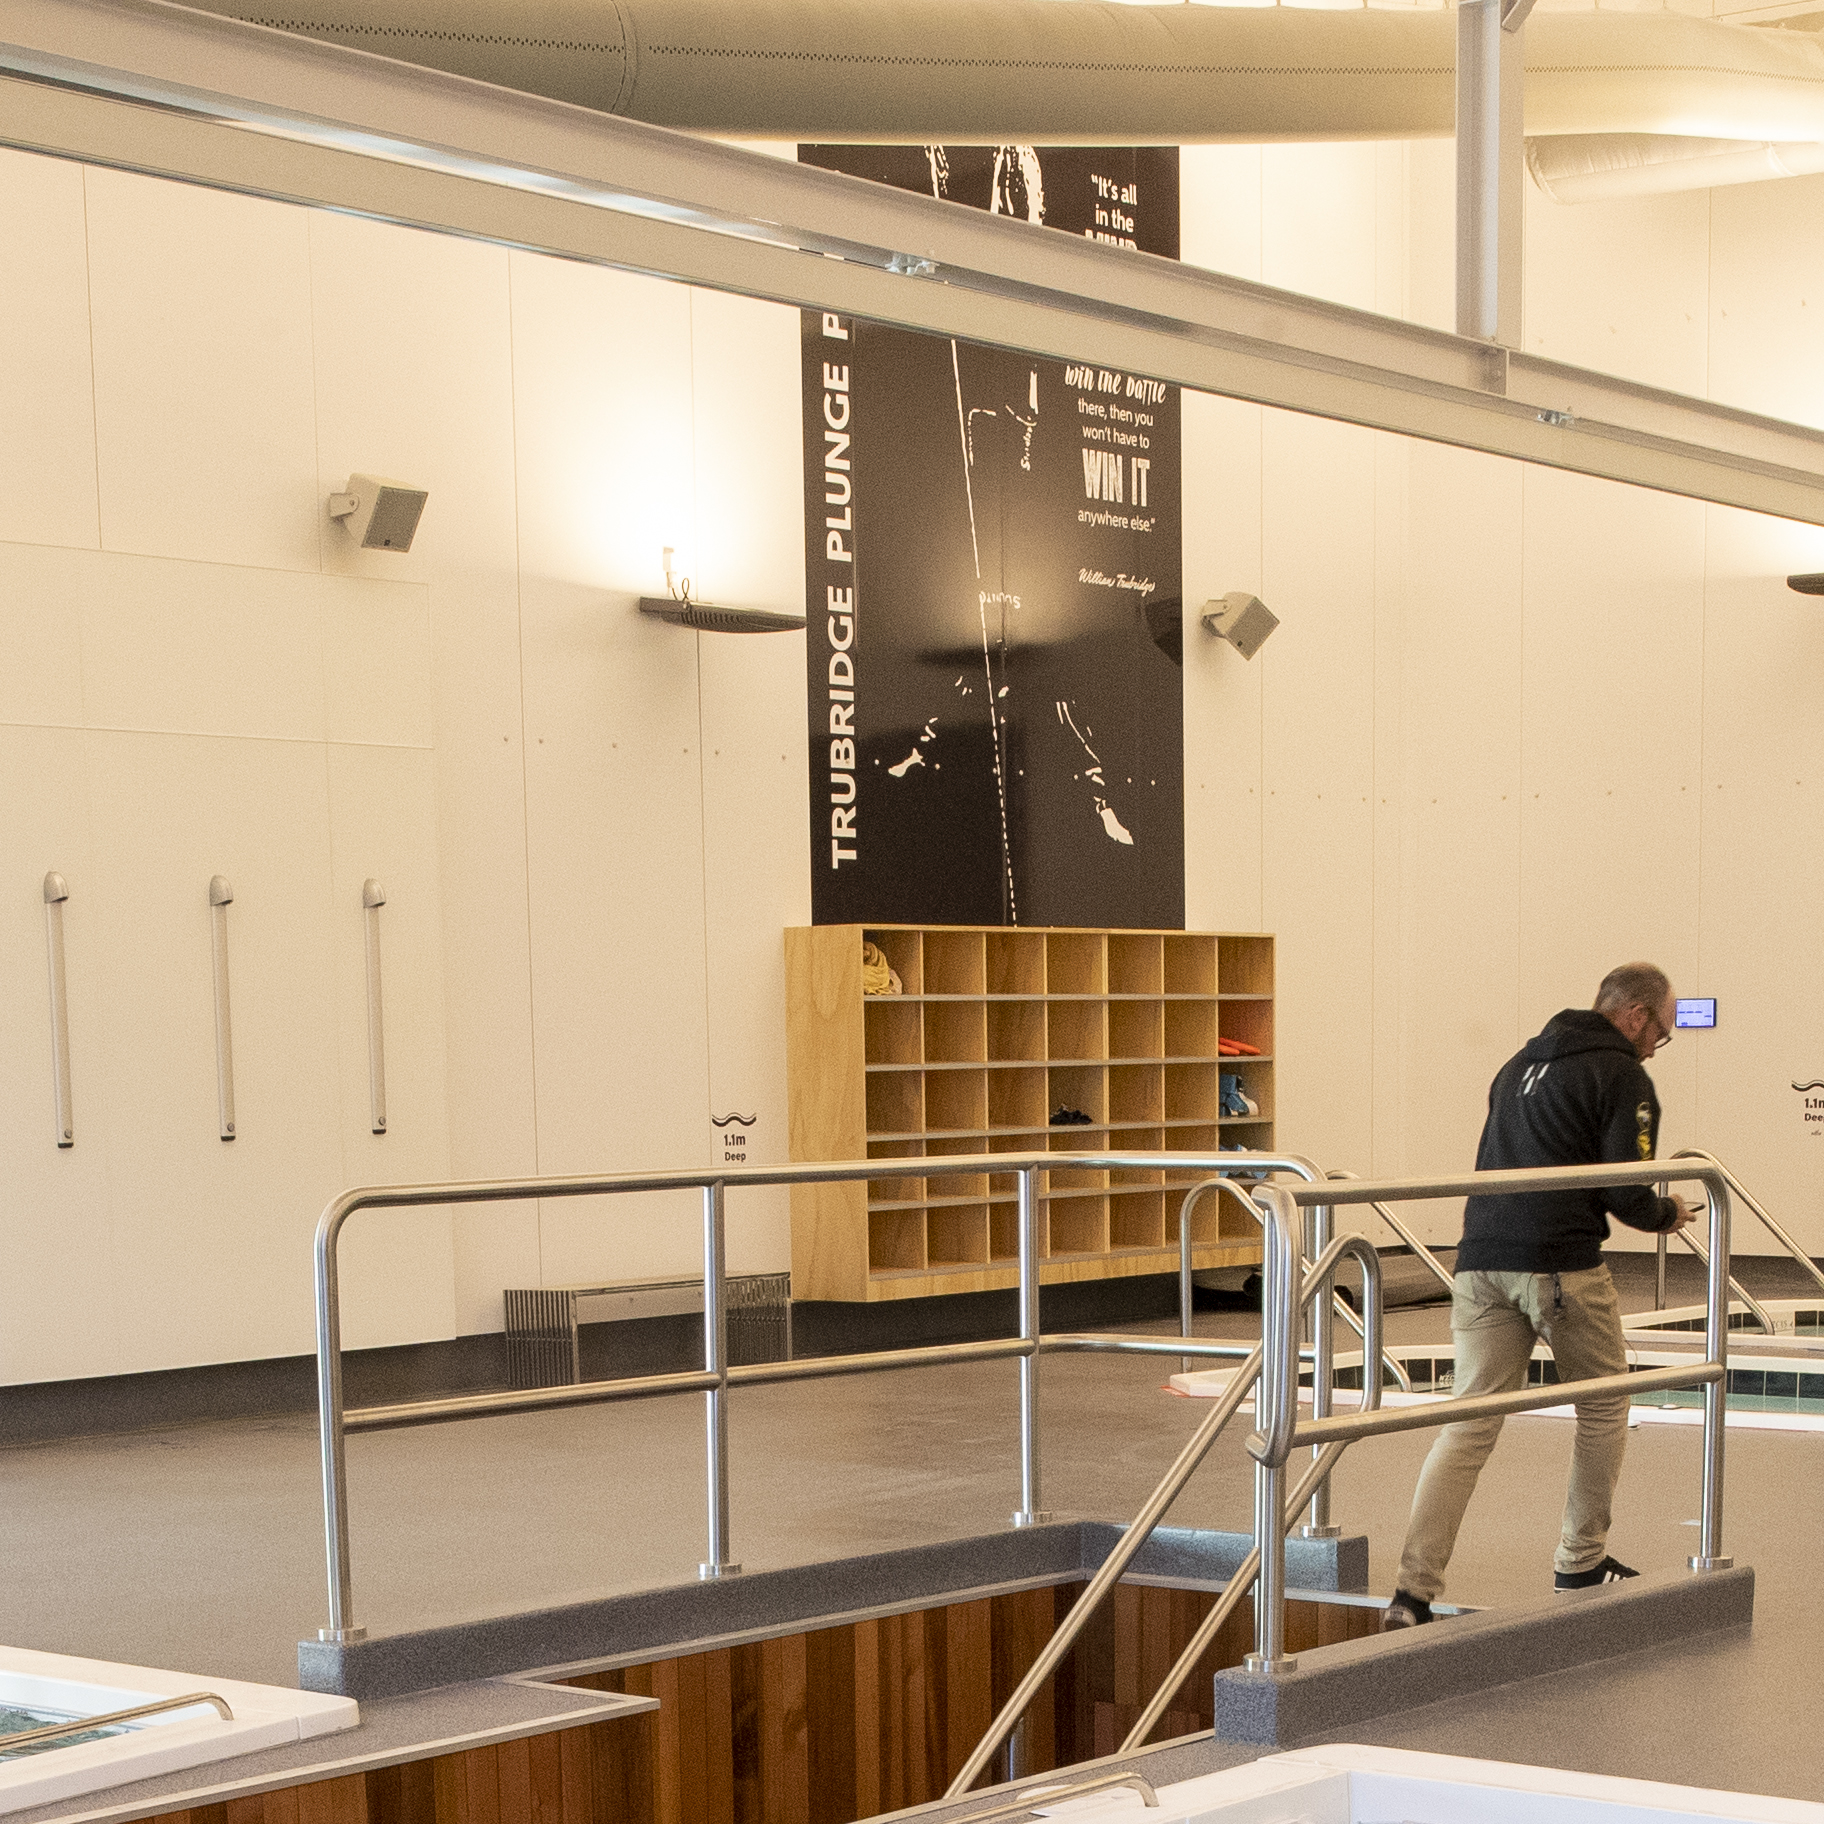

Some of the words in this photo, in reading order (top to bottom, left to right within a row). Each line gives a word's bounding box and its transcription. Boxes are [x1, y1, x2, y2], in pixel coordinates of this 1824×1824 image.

[1120, 183, 1138, 206] all
[1095, 203, 1109, 226] in
[1111, 209, 1134, 232] the
[1078, 397, 1107, 420] there,
[1109, 404, 1133, 423] then
[1135, 412, 1153, 427] you
[1082, 425, 1111, 443] won't
[1113, 427, 1138, 447] have
[1139, 433, 1150, 449] to
[821, 361, 854, 563] PLUNGE
[1082, 447, 1123, 504] WIN
[1131, 456, 1151, 508] IT
[1077, 509, 1129, 529] anywhere
[826, 586, 858, 869] TRUBRIDGE
[724, 1133, 746, 1147] 1.1m
[724, 1151, 747, 1163] Deep
